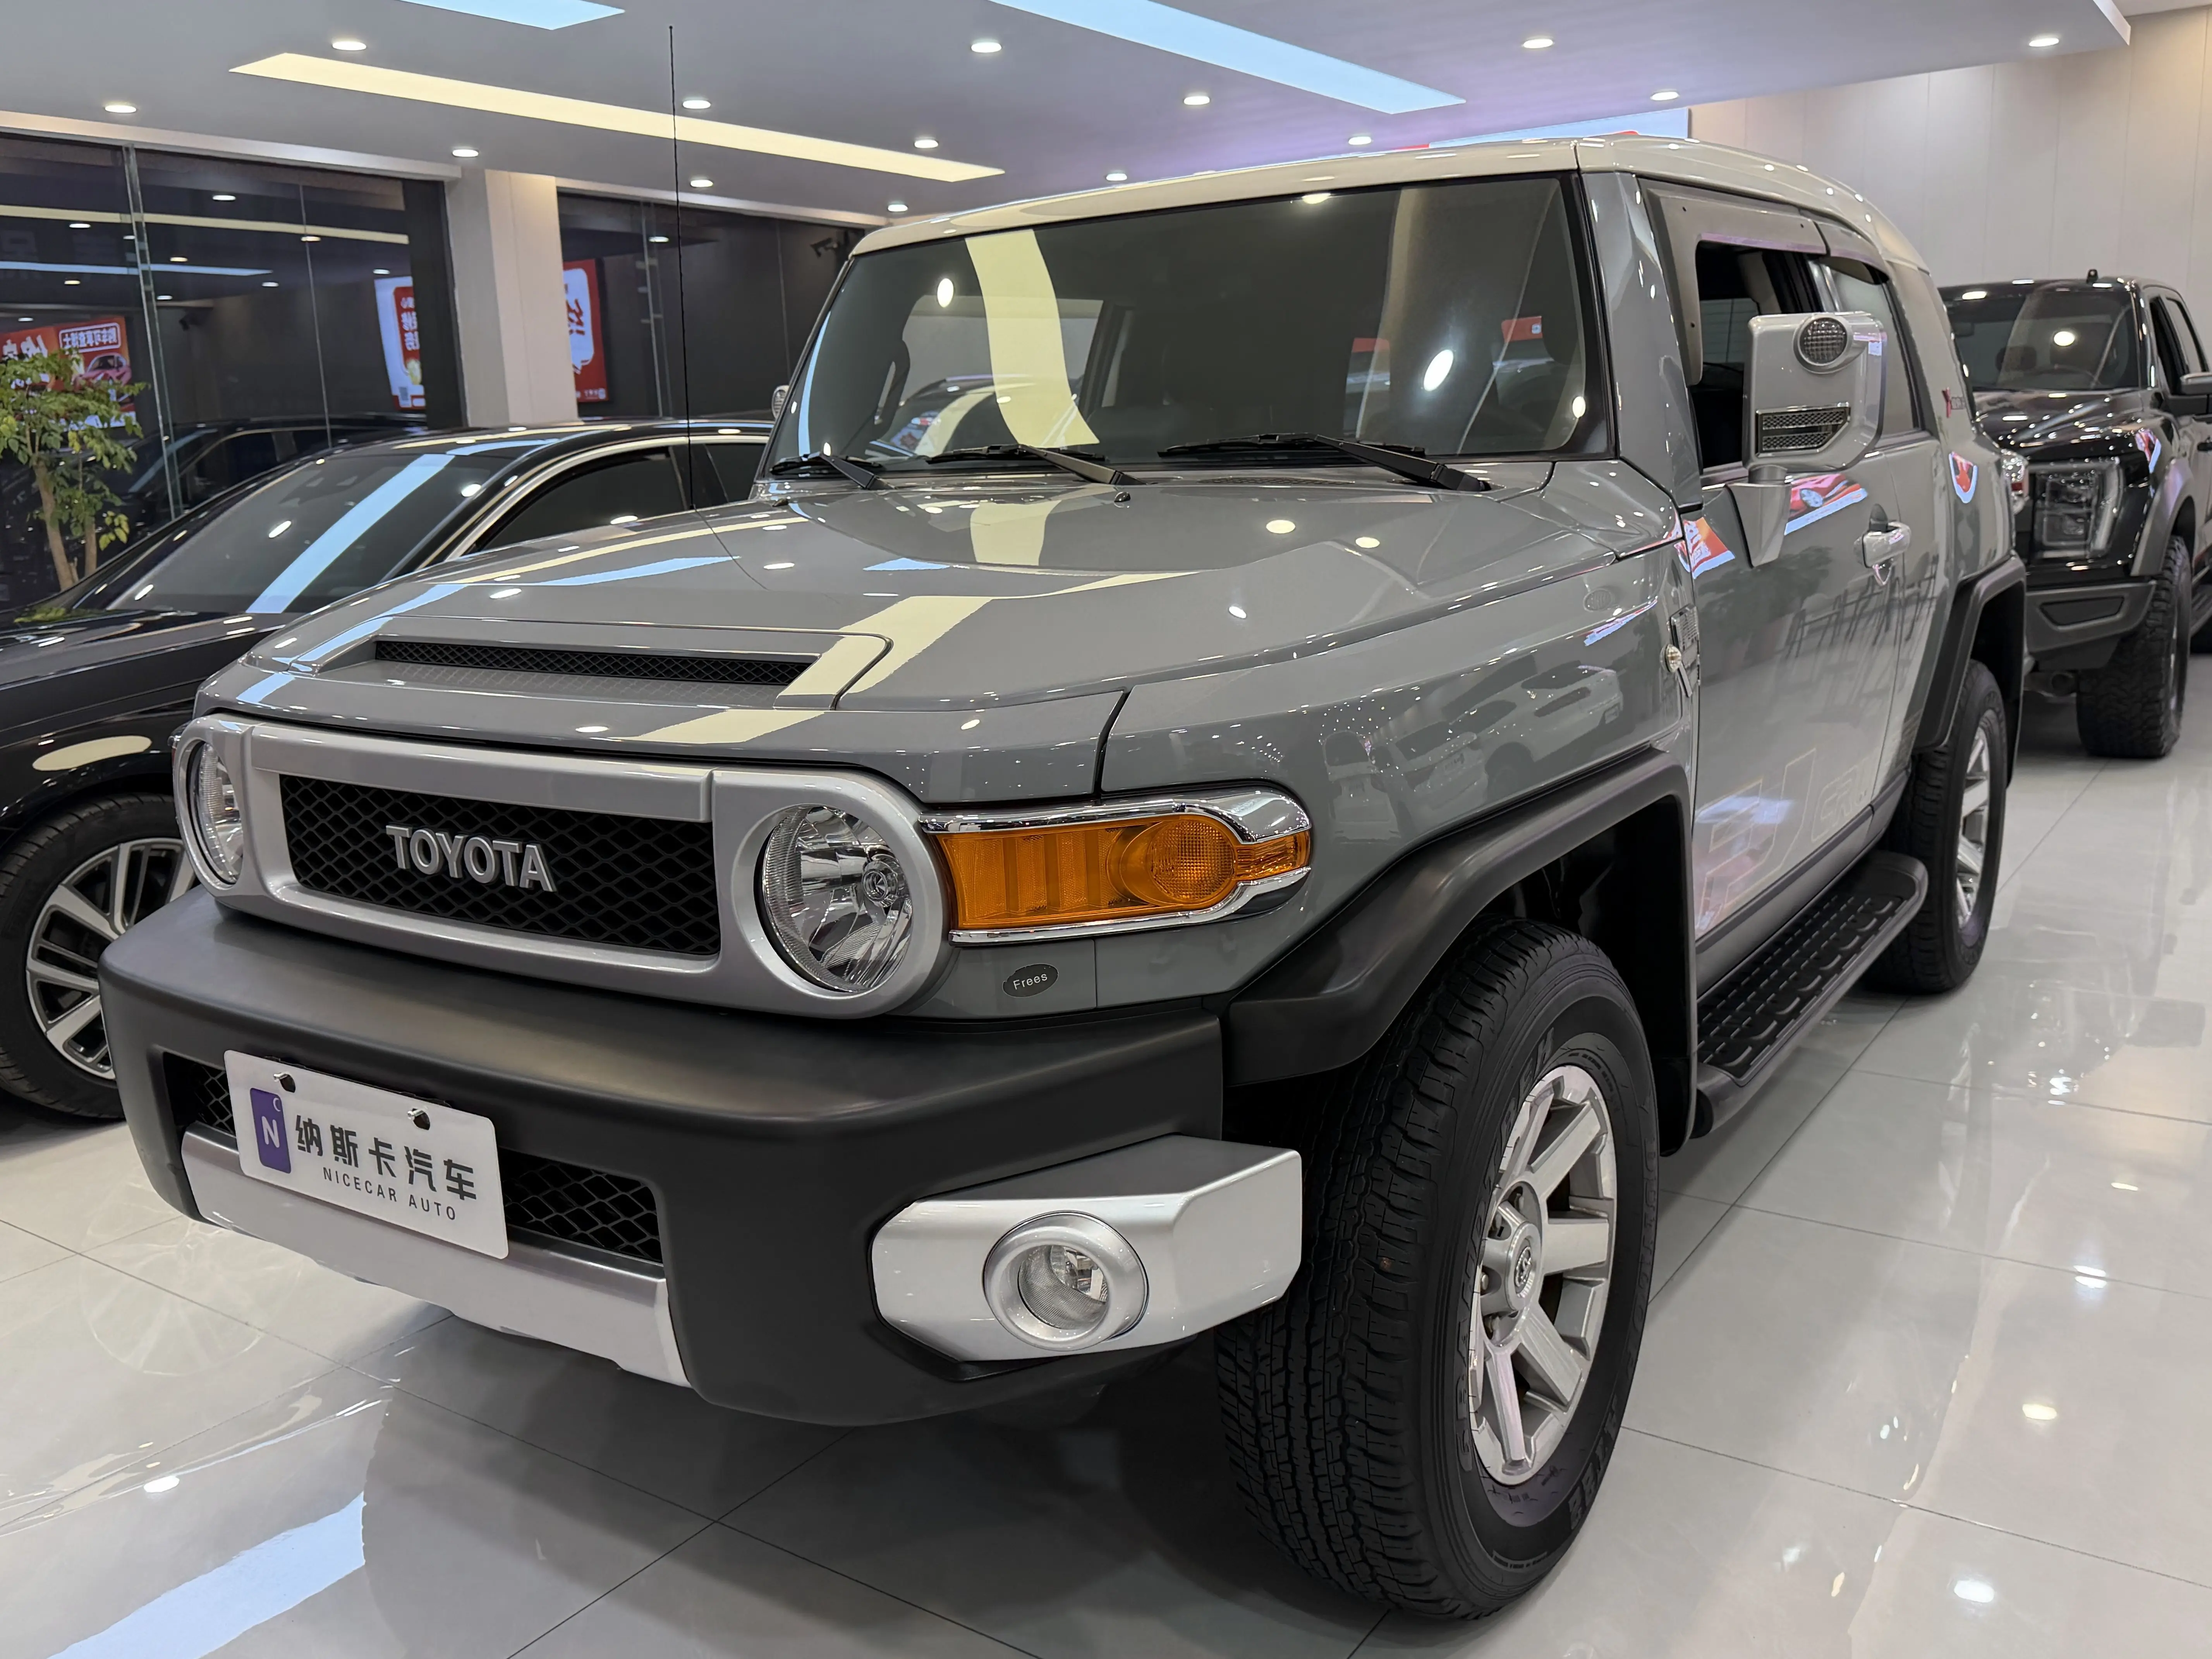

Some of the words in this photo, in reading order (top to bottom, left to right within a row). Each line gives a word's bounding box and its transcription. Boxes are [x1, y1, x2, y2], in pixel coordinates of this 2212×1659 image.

[386, 824, 557, 892] TOYOTA
[1013, 973, 1048, 990] Frees
[261, 1116, 280, 1148] N
[295, 1114, 477, 1201] 纳斯卡汽车
[323, 1166, 397, 1202] NICECAR
[409, 1194, 457, 1221] AUTO
